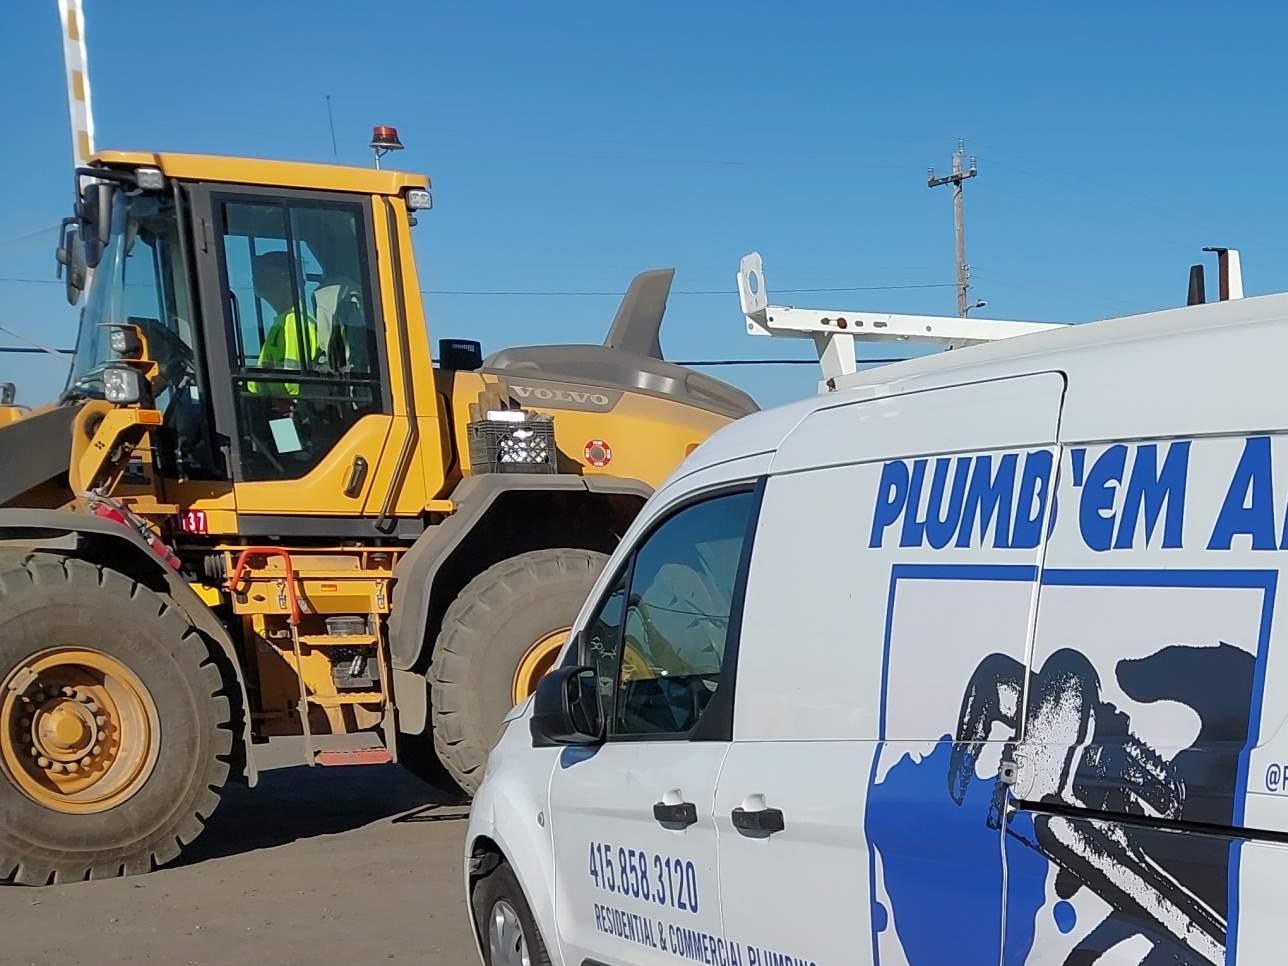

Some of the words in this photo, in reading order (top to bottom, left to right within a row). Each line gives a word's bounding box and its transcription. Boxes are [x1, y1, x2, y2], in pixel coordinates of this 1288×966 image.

[509, 385, 609, 405] VOLVO
[590, 842, 698, 913] 415.858.3120
[594, 903, 658, 949] RESIDENTIAL
[658, 921, 667, 951] &
